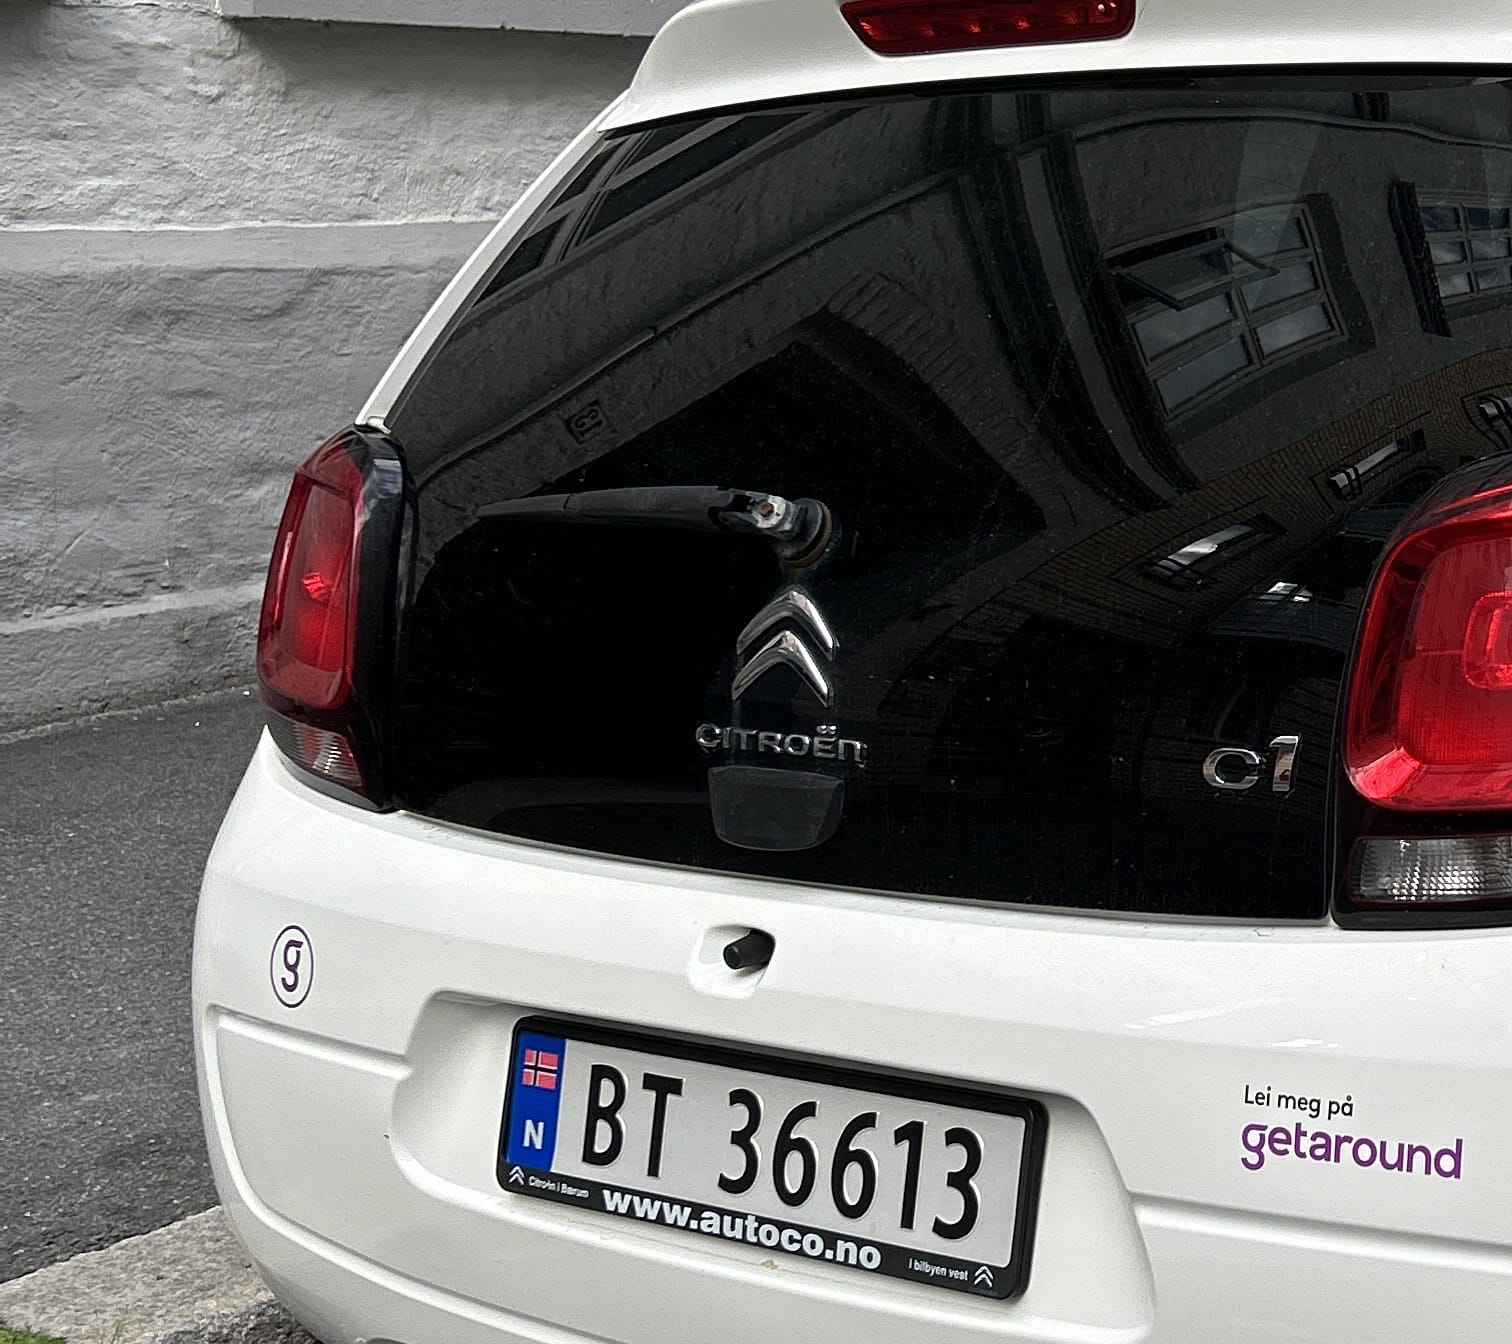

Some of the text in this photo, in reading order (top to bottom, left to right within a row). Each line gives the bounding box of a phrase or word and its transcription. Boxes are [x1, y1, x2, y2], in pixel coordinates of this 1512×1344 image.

[1203, 736, 1299, 792] C1
[1244, 1084, 1354, 1120] Lei meg på
[522, 1119, 544, 1150] N
[581, 1064, 986, 1242] BT 36613
[1241, 1122, 1463, 1179] getaround
[602, 1189, 882, 1270] www.autoco.no
